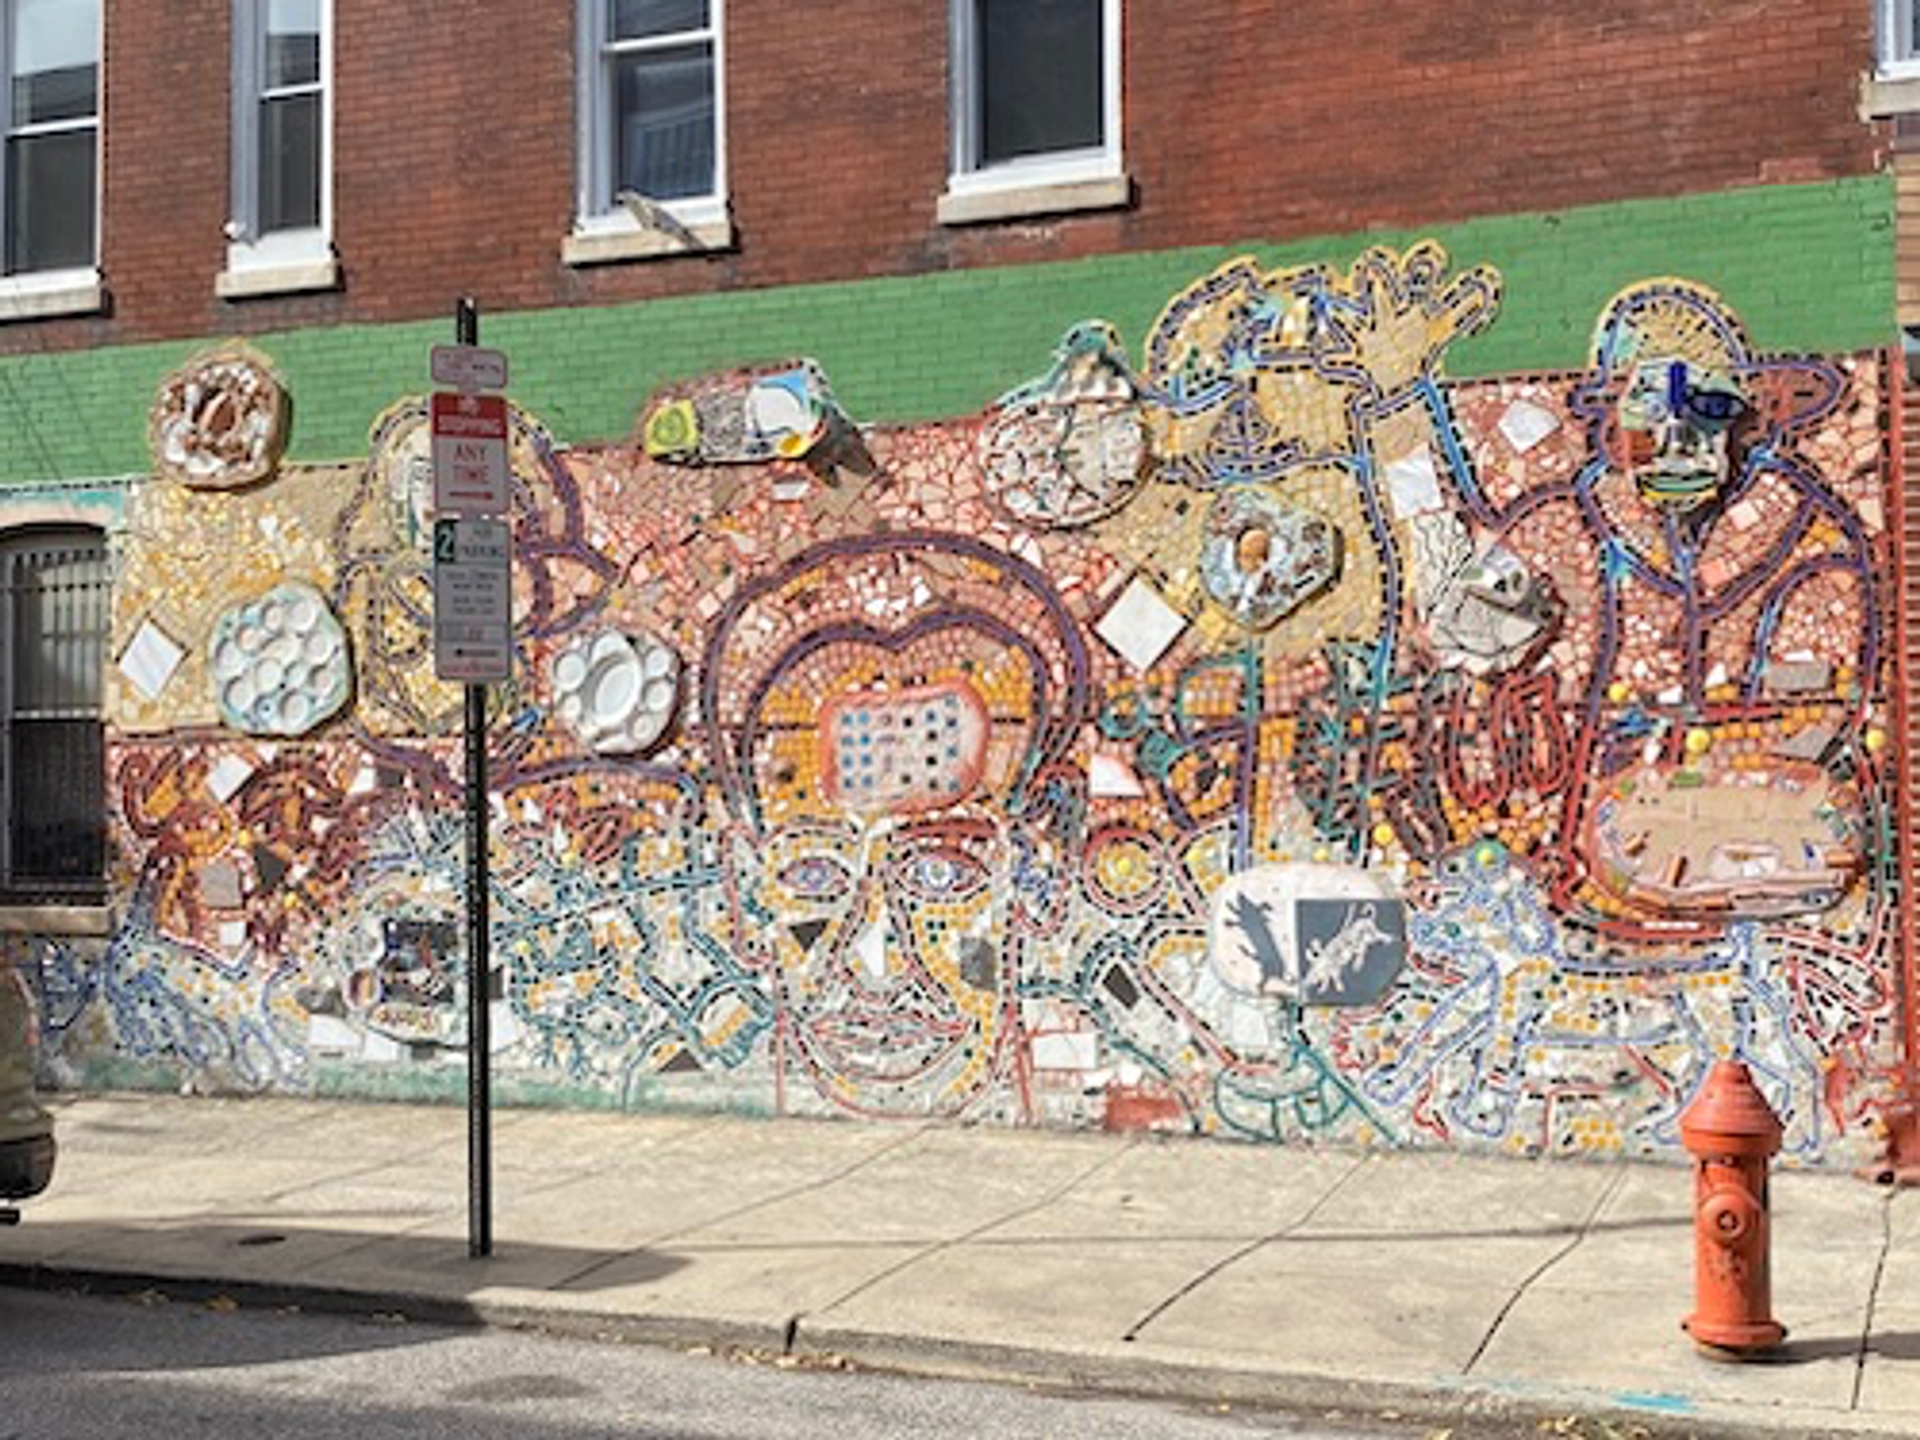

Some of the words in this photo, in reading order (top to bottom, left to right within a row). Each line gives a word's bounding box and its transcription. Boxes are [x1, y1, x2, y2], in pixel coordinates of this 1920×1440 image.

[453, 442, 488, 461] ANY
[453, 464, 489, 485] TIME
[439, 525, 454, 558] 2
